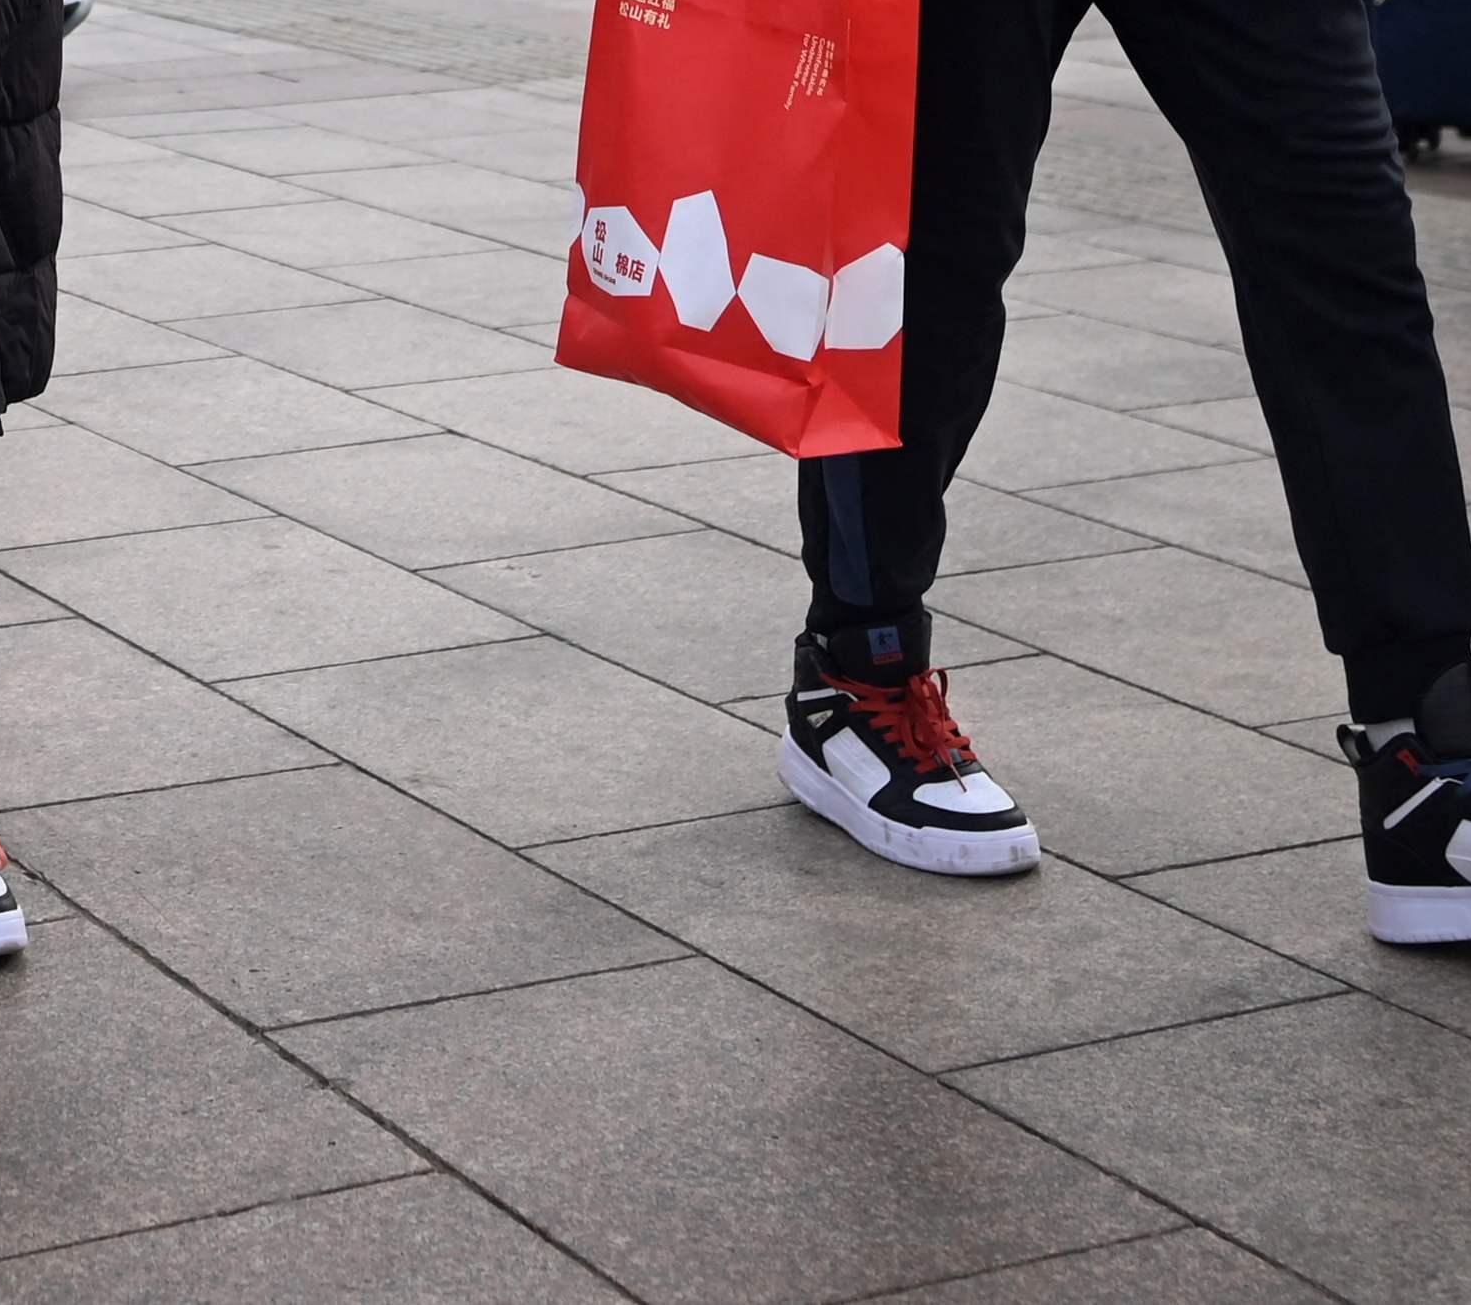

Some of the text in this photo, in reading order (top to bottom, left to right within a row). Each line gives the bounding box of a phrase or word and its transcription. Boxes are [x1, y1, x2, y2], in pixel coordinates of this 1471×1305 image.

[619, 1, 671, 30] 松山有礼
[592, 219, 606, 266] 松山
[615, 252, 646, 283] 棉店
